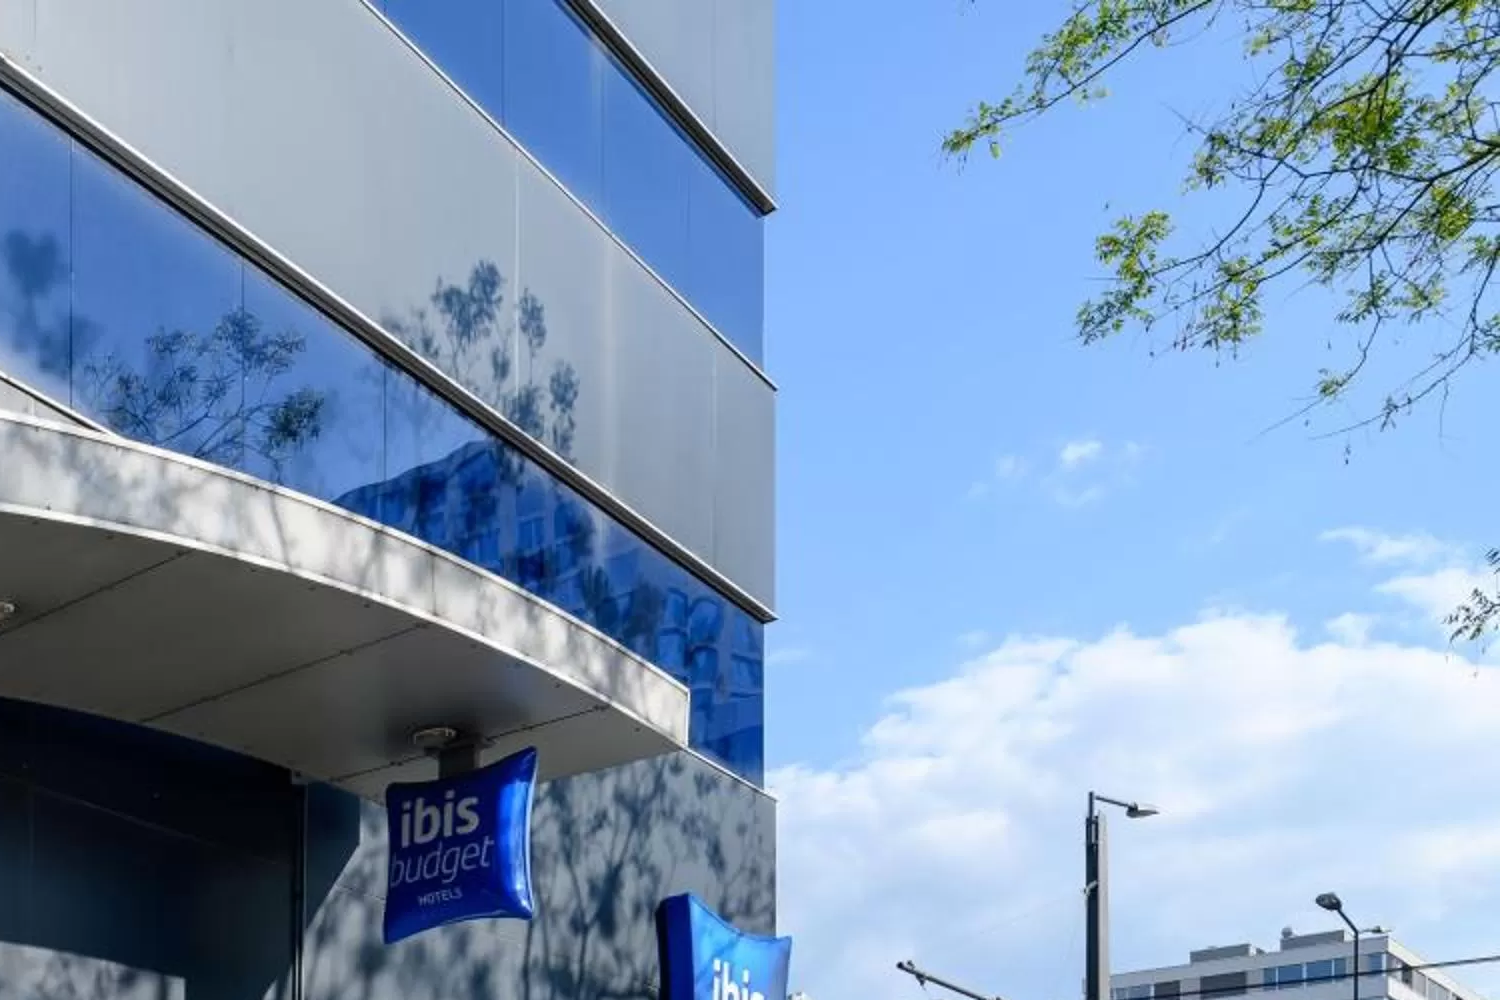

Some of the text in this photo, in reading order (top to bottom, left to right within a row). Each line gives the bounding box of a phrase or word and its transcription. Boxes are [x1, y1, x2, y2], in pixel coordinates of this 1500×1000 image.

[401, 789, 480, 848] ibis
[390, 835, 495, 887] budget
[417, 886, 463, 906] HOTELS
